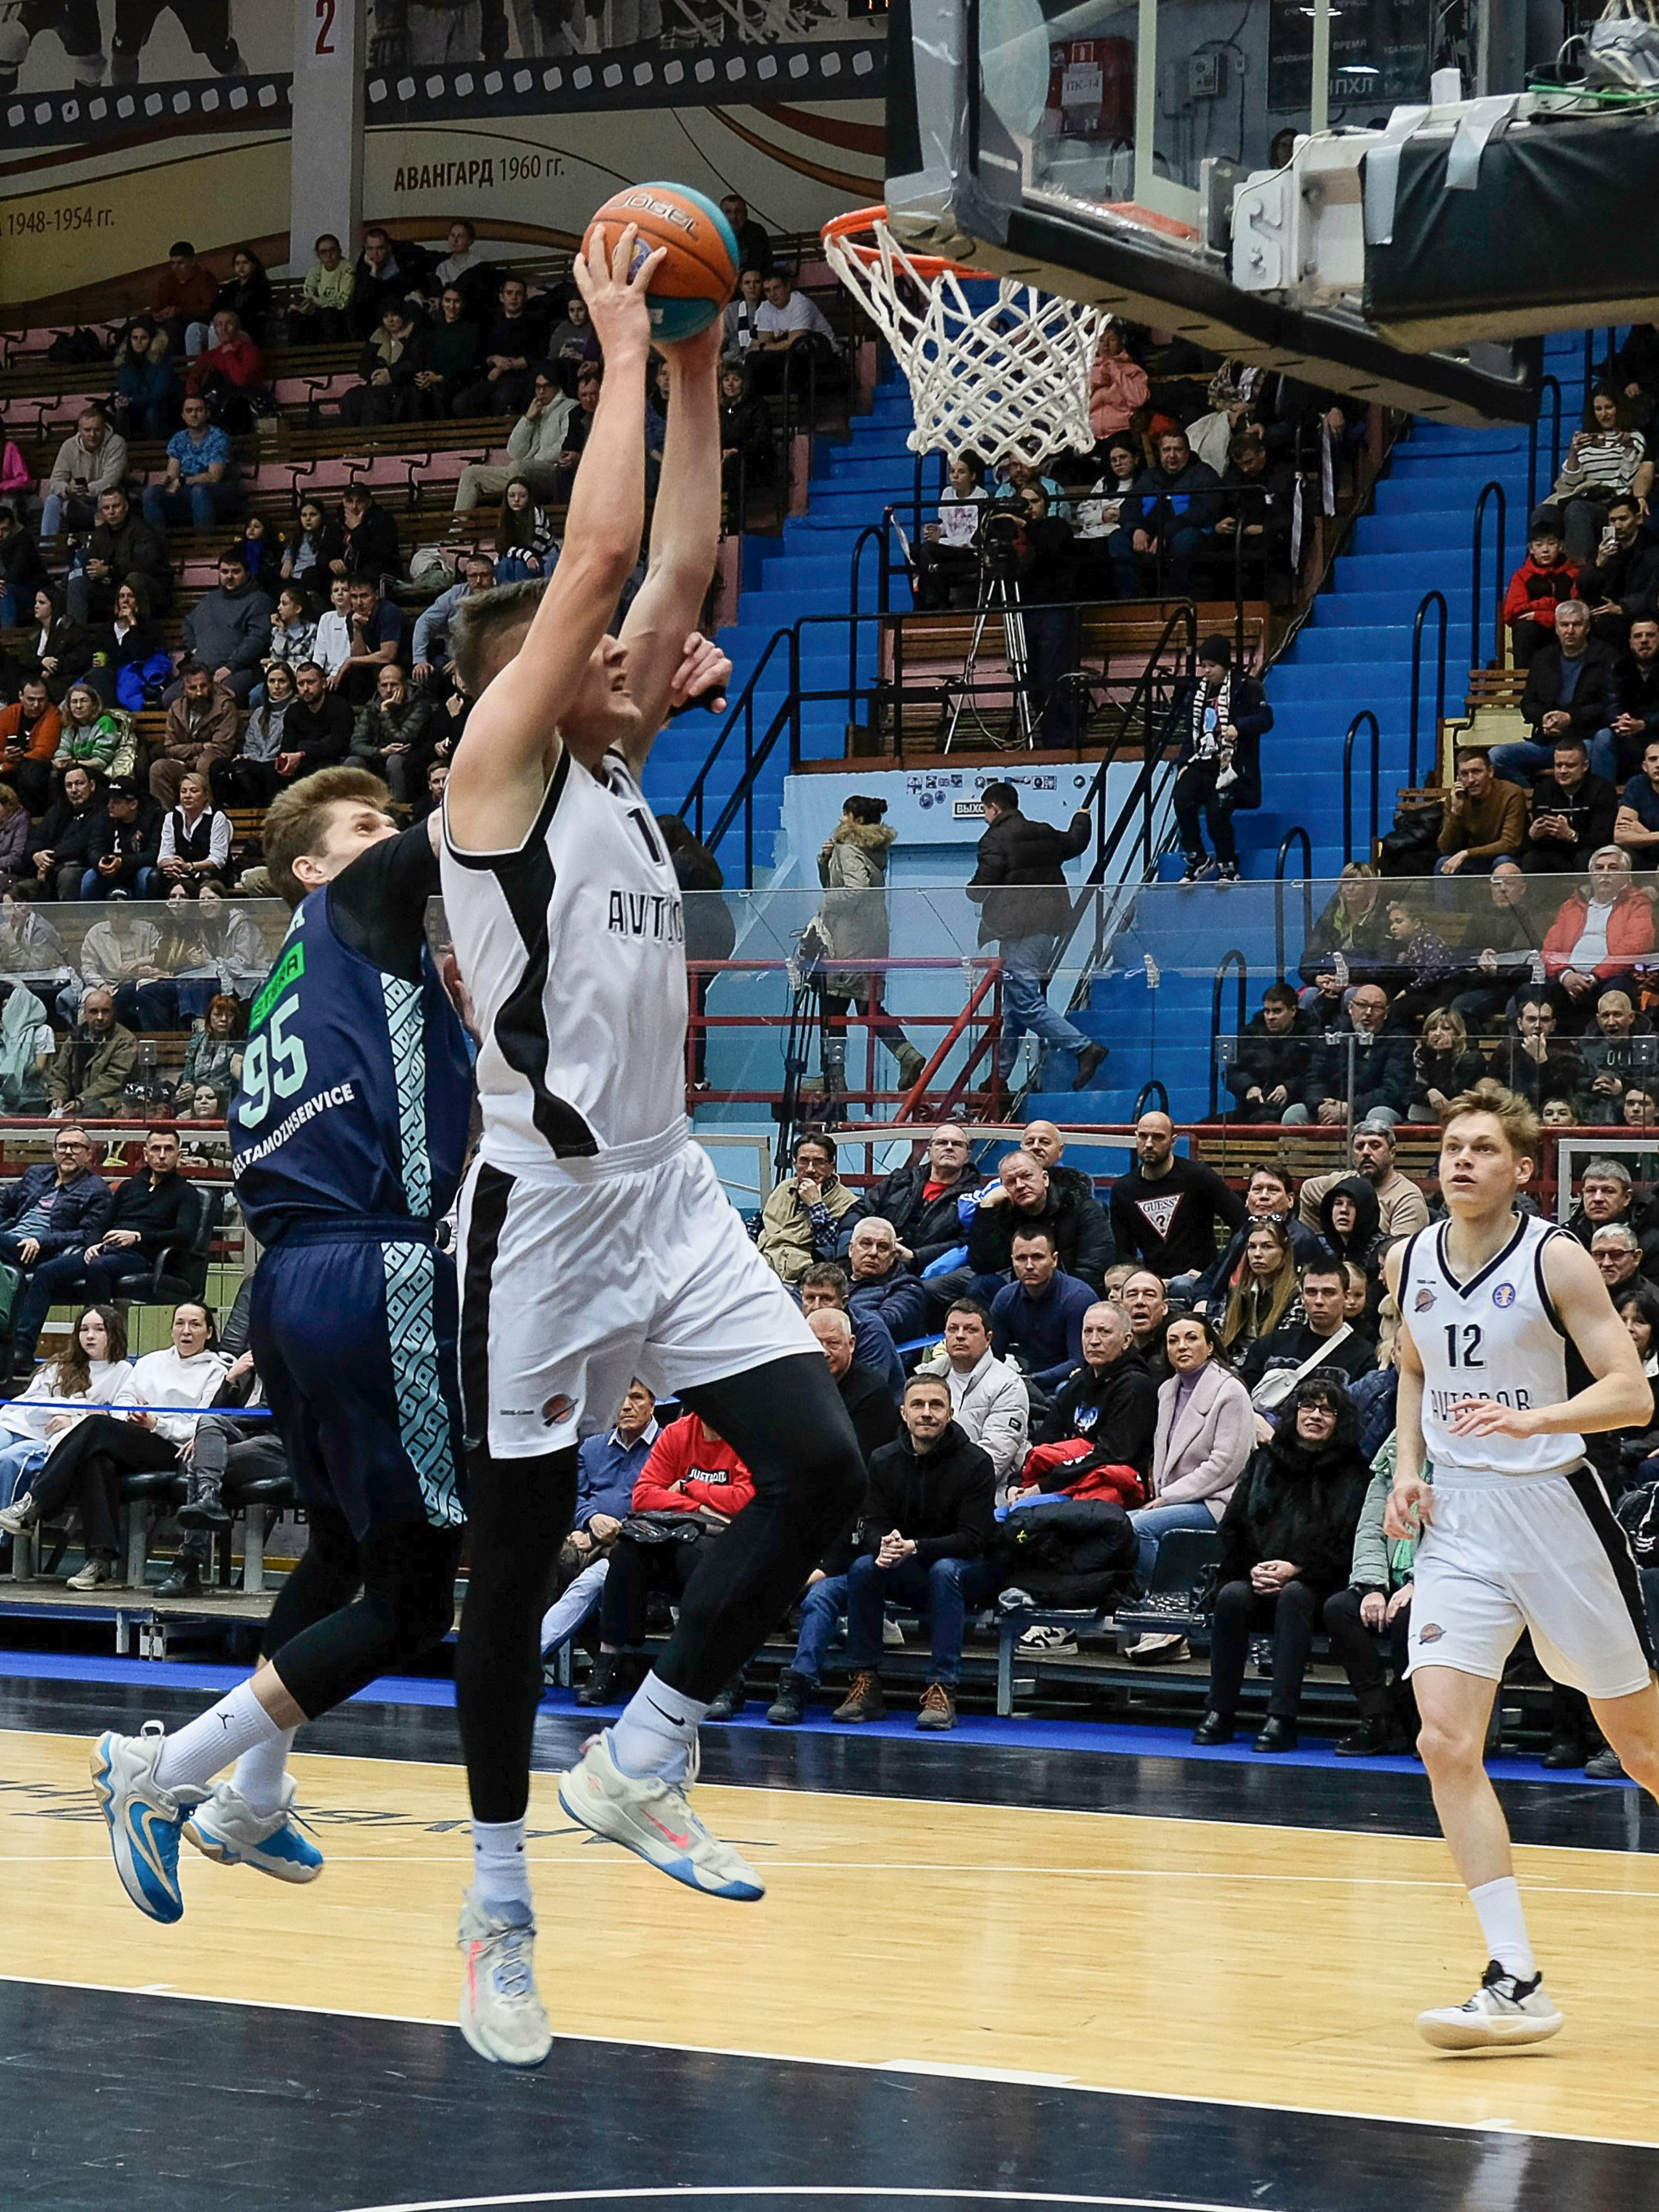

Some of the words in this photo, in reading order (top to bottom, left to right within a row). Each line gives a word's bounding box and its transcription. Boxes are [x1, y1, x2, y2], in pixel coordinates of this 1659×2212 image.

[316, 0, 335, 54] 2
[1332, 39, 1367, 51] ВРЕМЯ
[394, 159, 494, 191] АВАНГАРД
[500, 155, 540, 181] 1960
[546, 157, 564, 177] гг.
[8, 206, 93, 236] 1948-1954
[98, 209, 115, 227] гг.
[957, 804, 984, 813] ВЫХО
[238, 993, 308, 1128] 95
[1143, 1198, 1175, 1212] GUESS
[1444, 1323, 1485, 1369] 12
